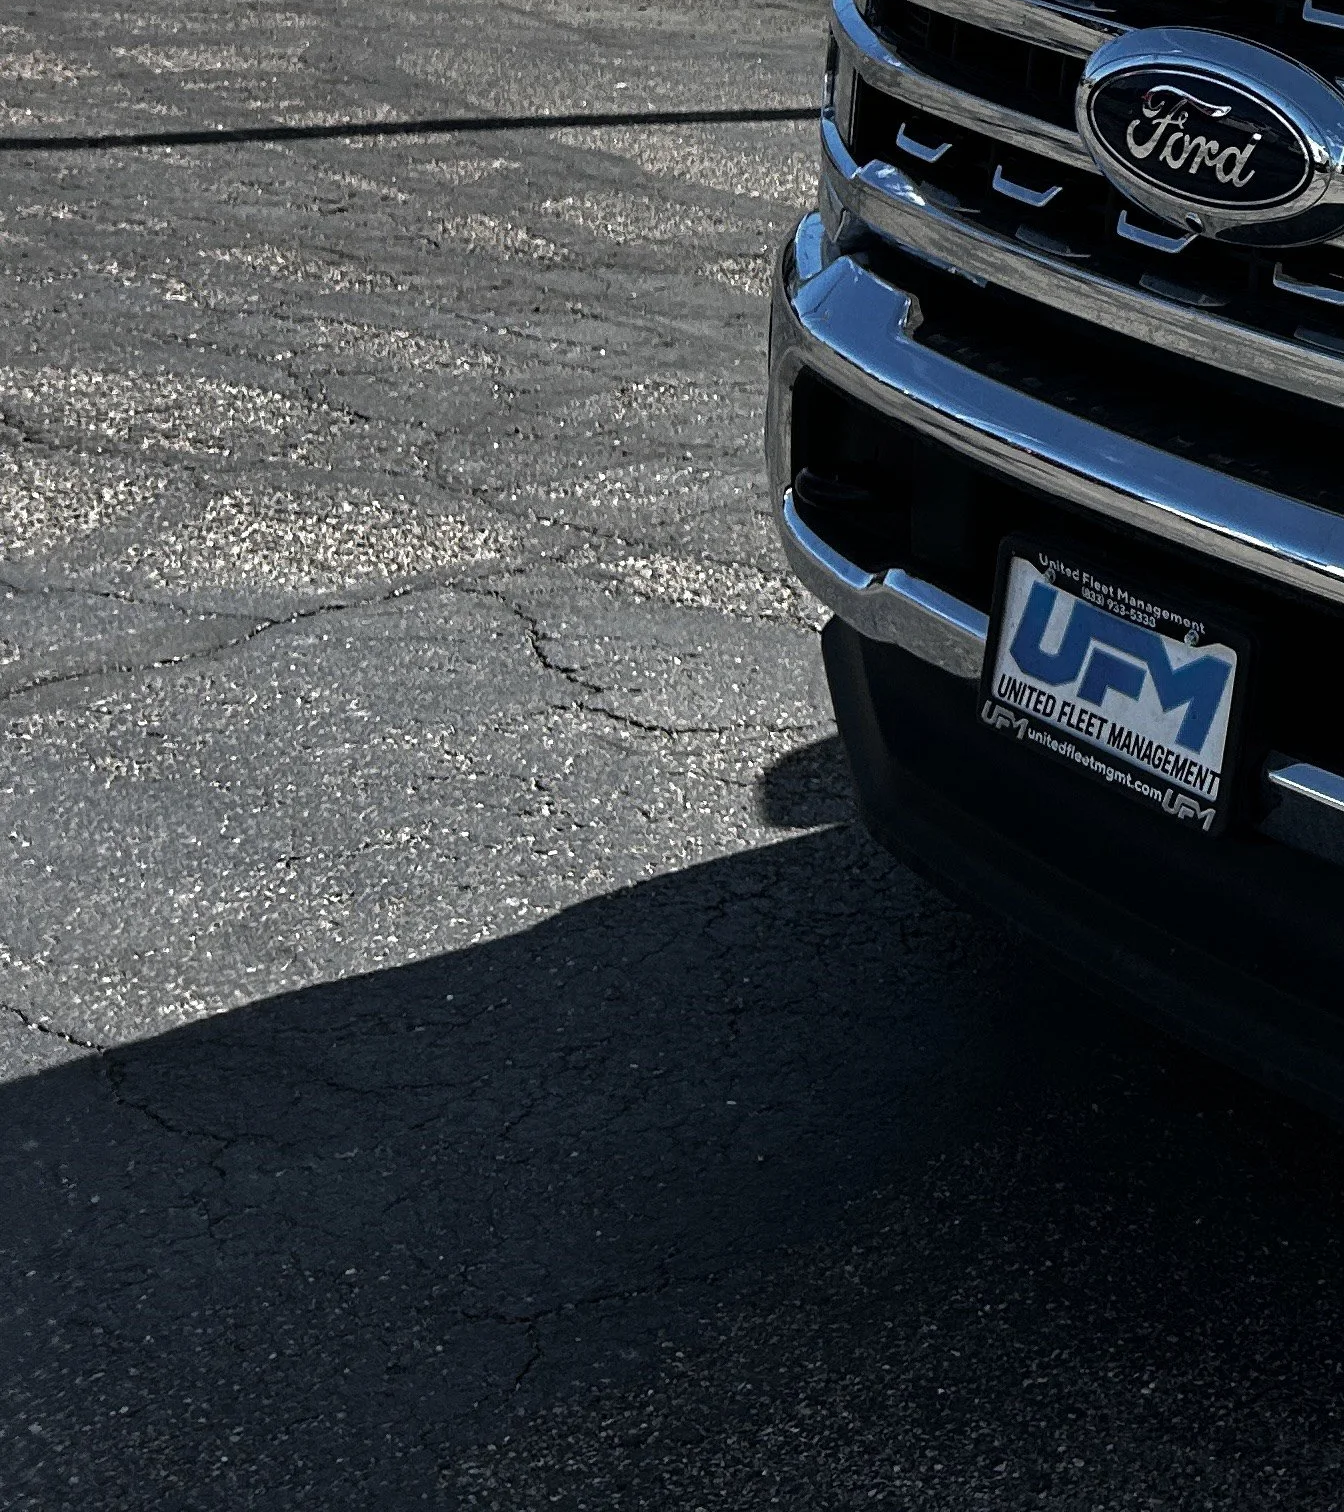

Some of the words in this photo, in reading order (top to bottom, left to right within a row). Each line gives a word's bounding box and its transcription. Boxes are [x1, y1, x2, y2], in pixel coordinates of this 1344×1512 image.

[1126, 85, 1262, 189] Ford
[1039, 552, 1080, 582] United
[1082, 572, 1114, 598] Fleet
[1117, 588, 1206, 634] Management
[1010, 580, 1233, 755] UFM
[998, 674, 1056, 718] UNITED
[1057, 702, 1108, 740] FLEET
[1106, 722, 1222, 796] MANAGEMENT
[1027, 728, 1163, 802] unitedfleetmgmt.com
